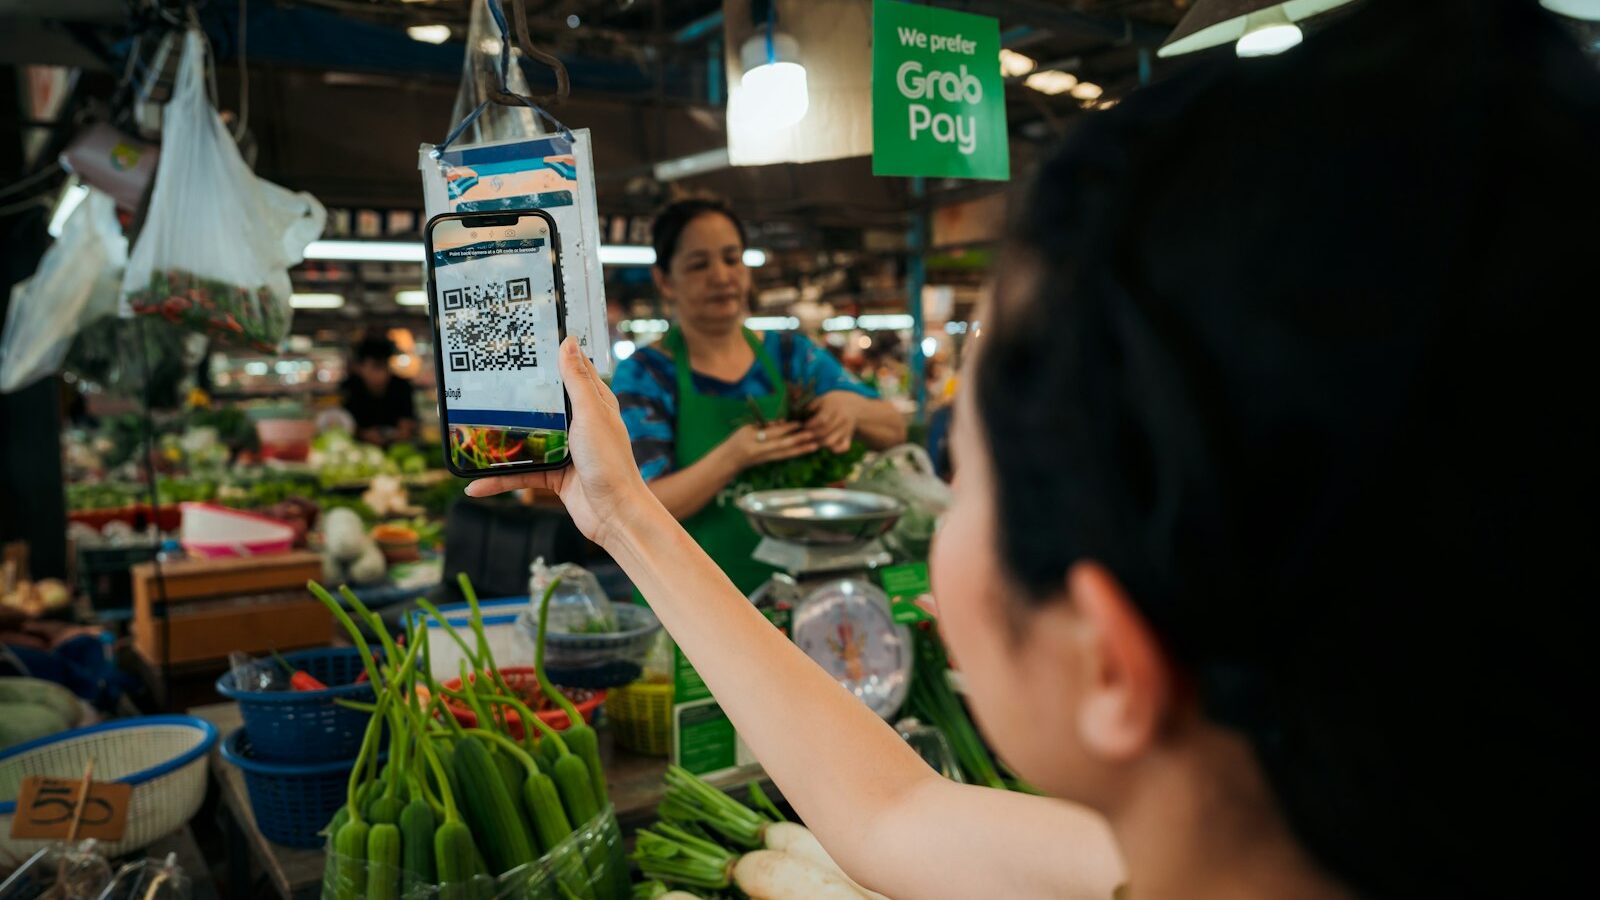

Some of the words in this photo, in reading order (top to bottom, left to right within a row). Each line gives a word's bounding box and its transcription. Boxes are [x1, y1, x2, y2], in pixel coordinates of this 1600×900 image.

[898, 26, 927, 48] We
[930, 34, 977, 55] prefer
[896, 60, 983, 105] Grab
[908, 104, 976, 155] Pay
[30, 787, 114, 826] 50
